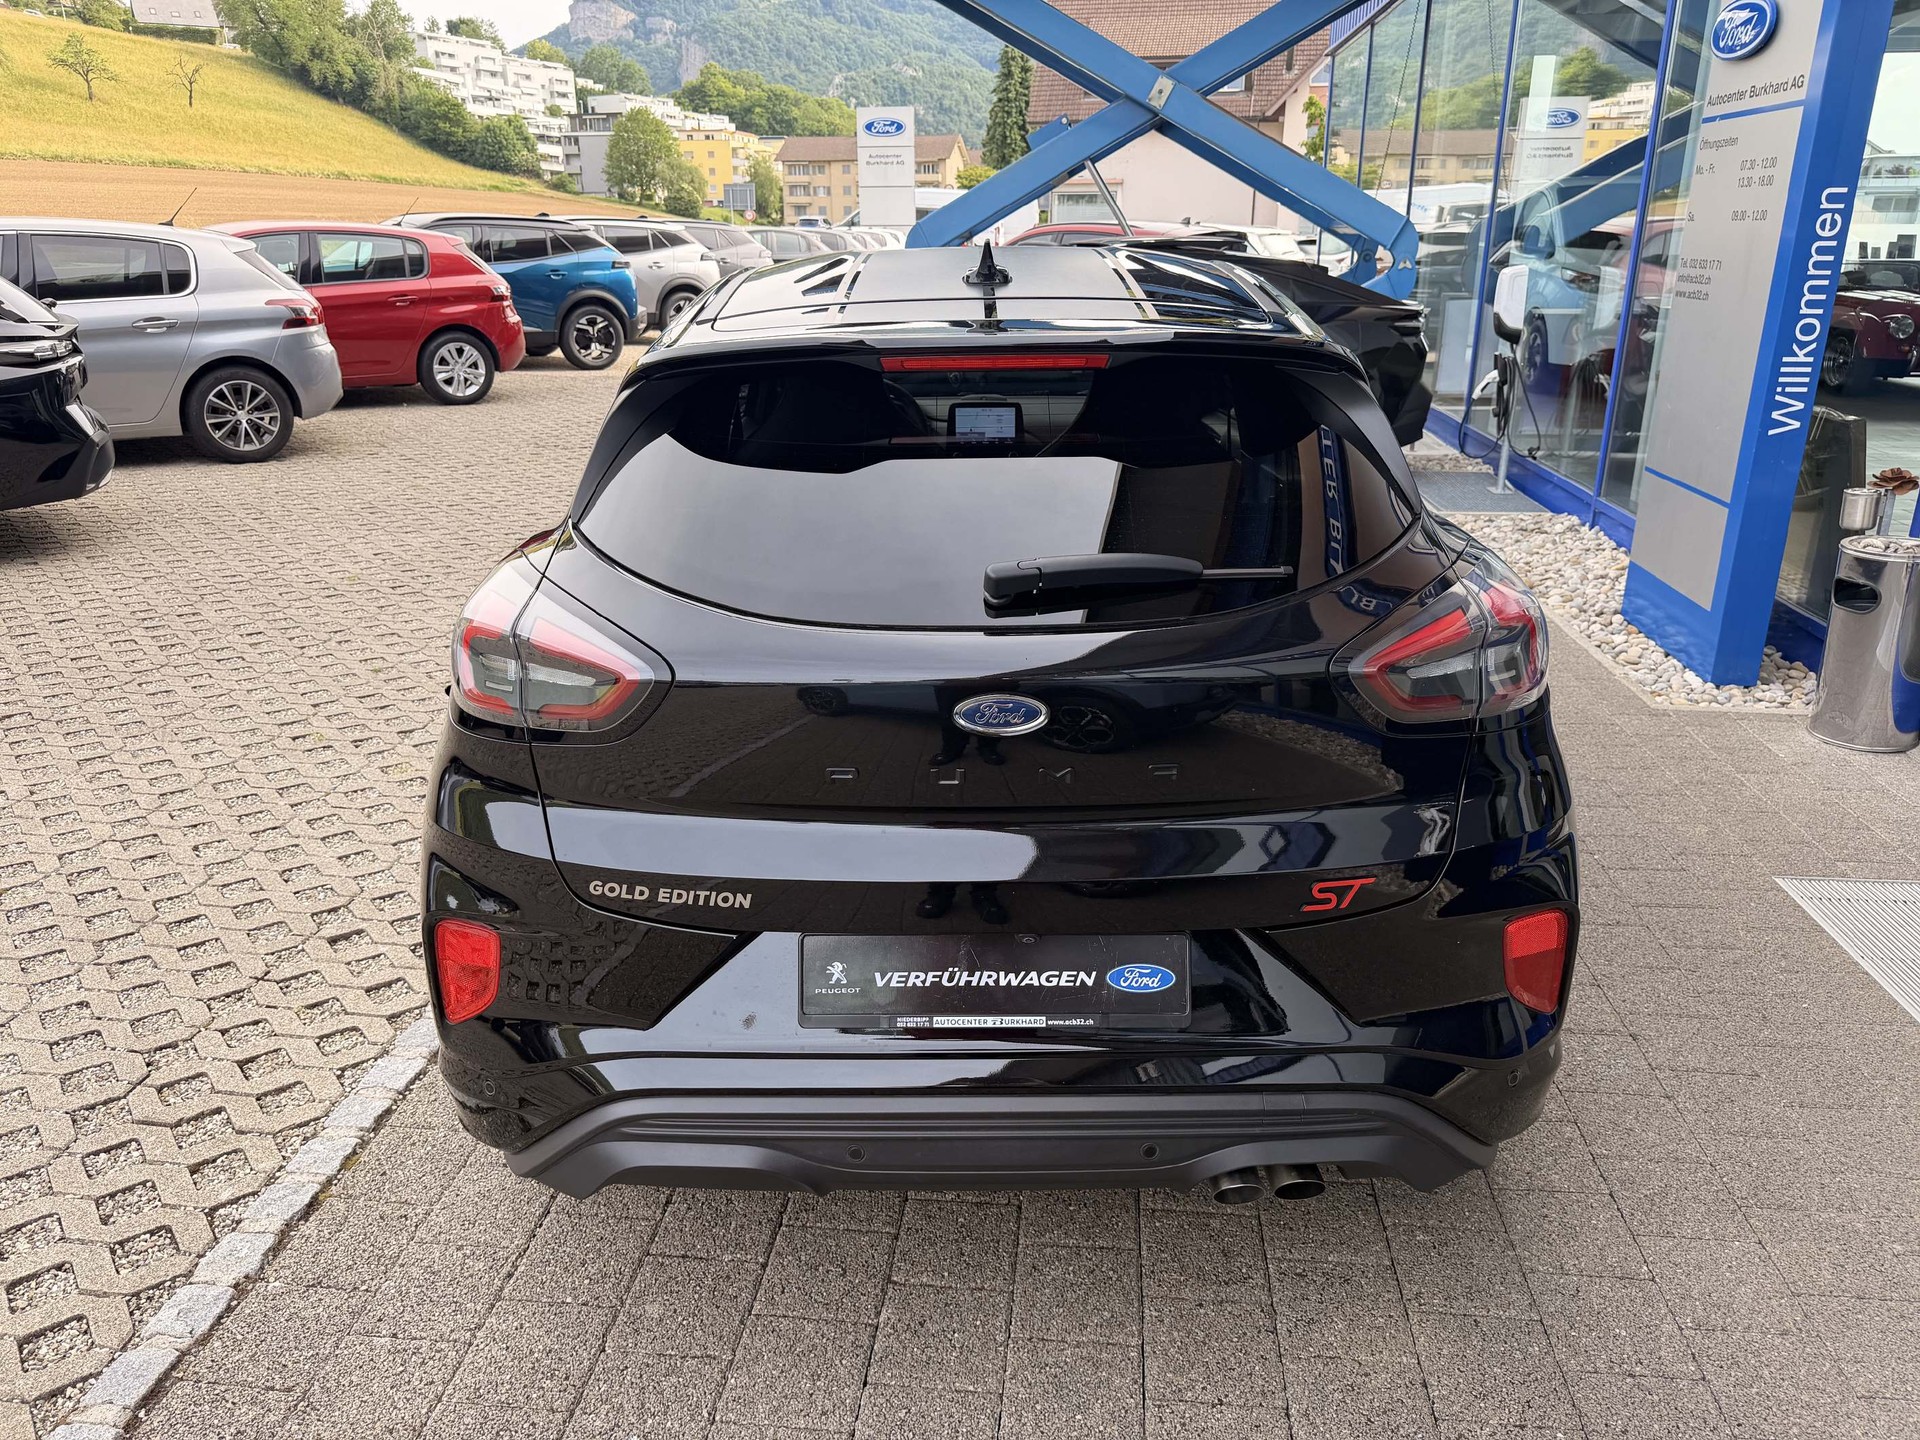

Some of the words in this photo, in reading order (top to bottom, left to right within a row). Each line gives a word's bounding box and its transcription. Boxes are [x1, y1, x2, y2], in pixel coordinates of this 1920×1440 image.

[1706, 88, 1748, 107] Autocenter
[1749, 78, 1790, 99] Burkhard
[1790, 74, 1805, 91] AG
[871, 120, 898, 133] Ford
[1699, 136, 1739, 152] Öffnungszeiten
[1695, 164, 1704, 175] Mo.
[1708, 163, 1716, 174] Fr.
[1739, 159, 1756, 172] 07.30
[1760, 156, 1778, 169] 12.00
[1737, 176, 1753, 188] 13.30
[1757, 174, 1775, 187] 18.00
[1731, 210, 1747, 222] 09.00
[1752, 209, 1768, 221] 12.00
[1689, 258, 1698, 269] 032
[1674, 288, 1710, 301] www.acb32.ch
[1767, 186, 1849, 436] Willkommen
[974, 702, 1026, 725] Ford
[588, 880, 650, 901] GOLD
[657, 887, 753, 909] EDITION
[1300, 876, 1378, 913] ST
[874, 967, 1097, 988] VERFÜHRWAGEN
[1119, 967, 1162, 988] Ford
[934, 1018, 988, 1026] AUTOCENTER
[990, 1017, 1045, 1026] BURKHARD
